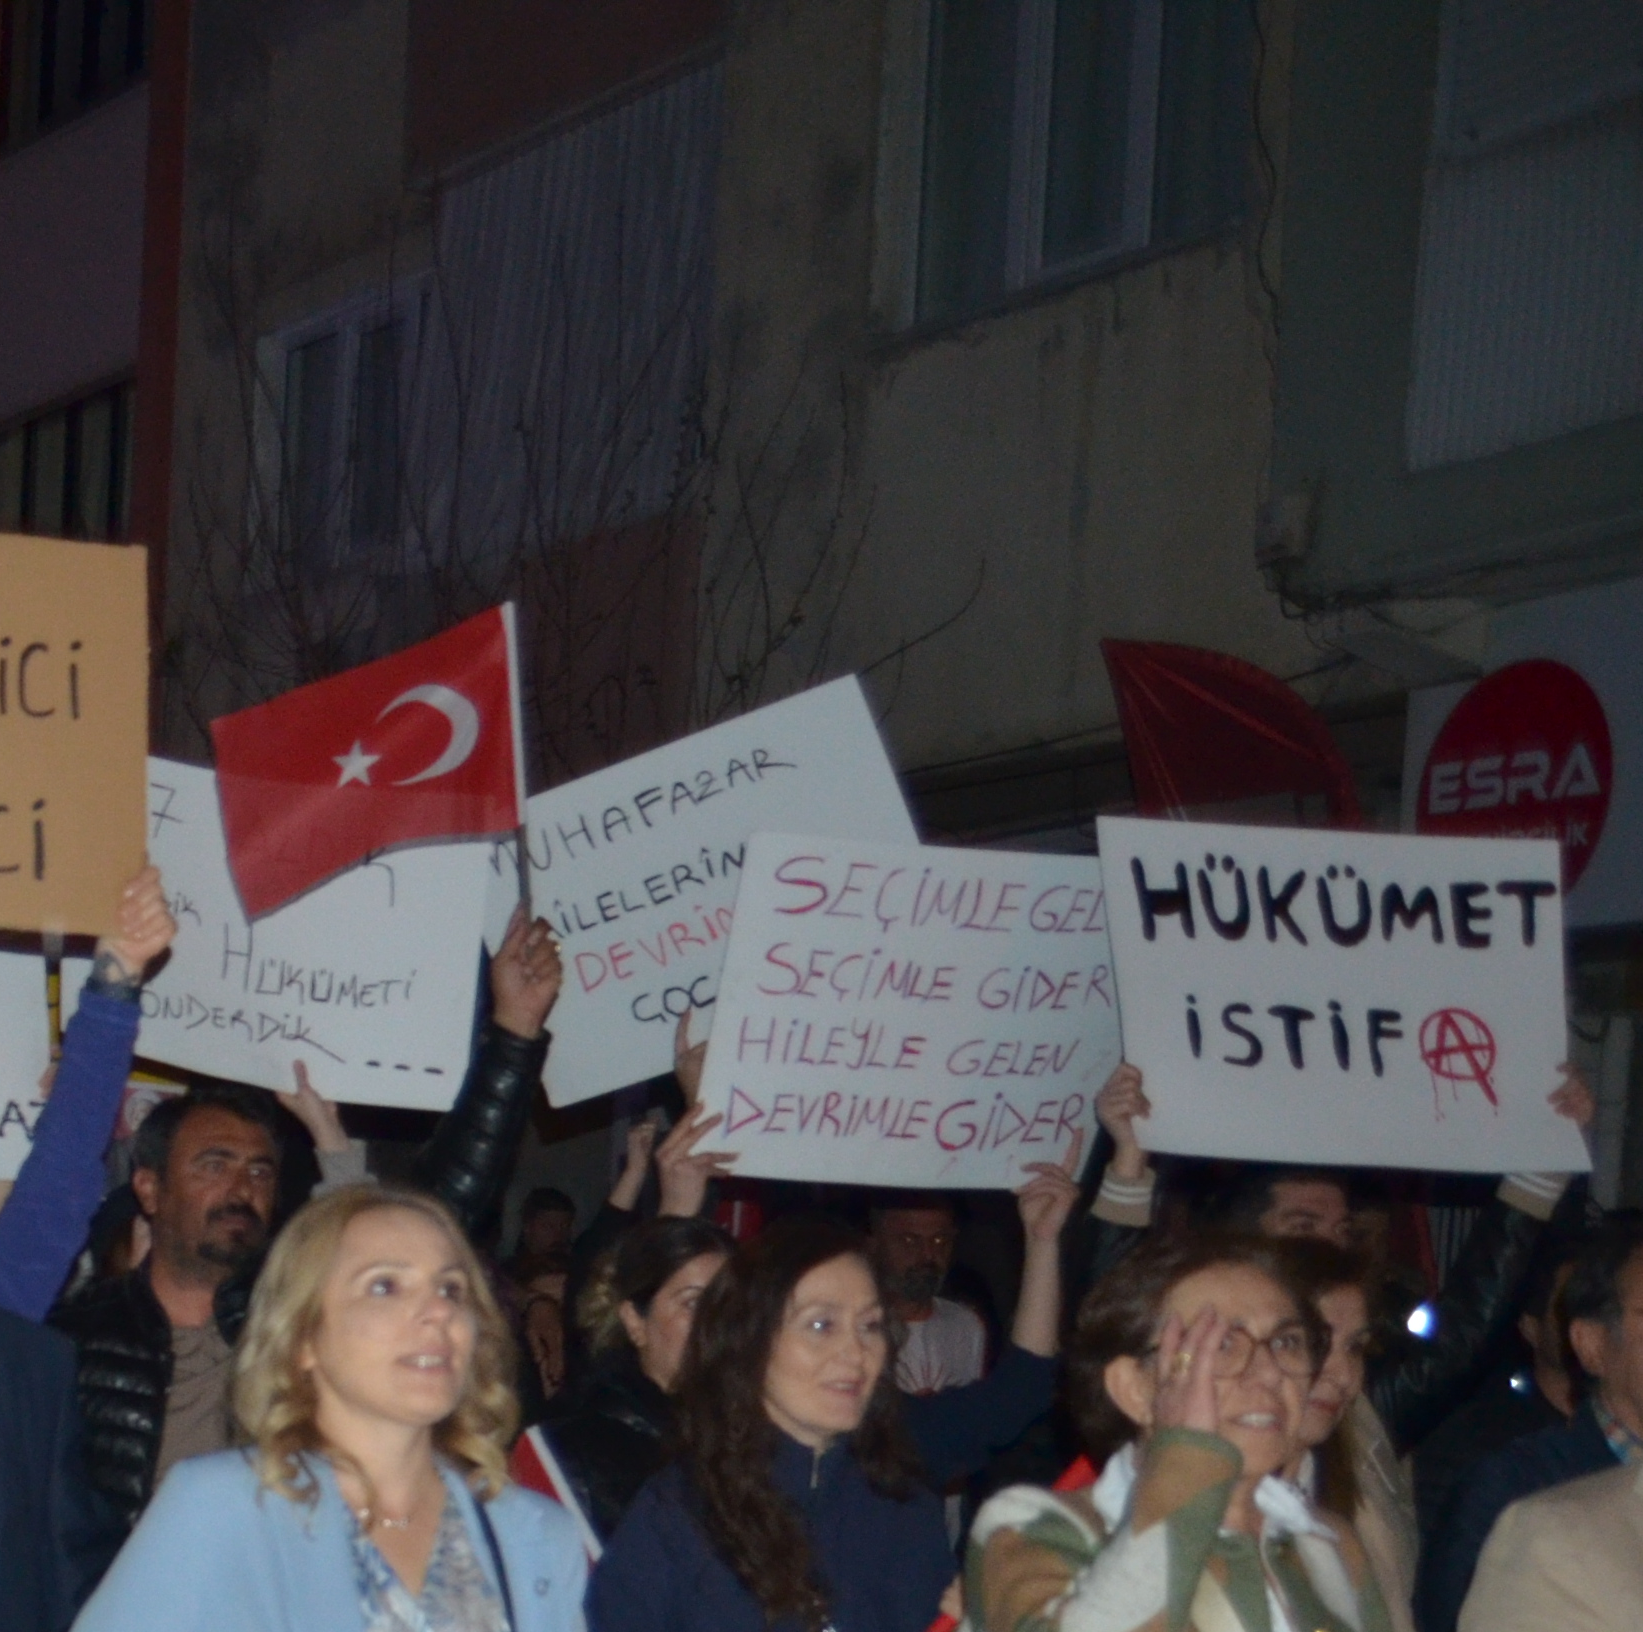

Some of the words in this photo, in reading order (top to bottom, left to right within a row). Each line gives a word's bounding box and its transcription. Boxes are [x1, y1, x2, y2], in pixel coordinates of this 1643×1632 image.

[1427, 741, 1602, 816] ESRA
[549, 842, 746, 940] İLELERİN
[1129, 853, 1558, 949] HÜKÜMET
[945, 1038, 1080, 1078] GELEN
